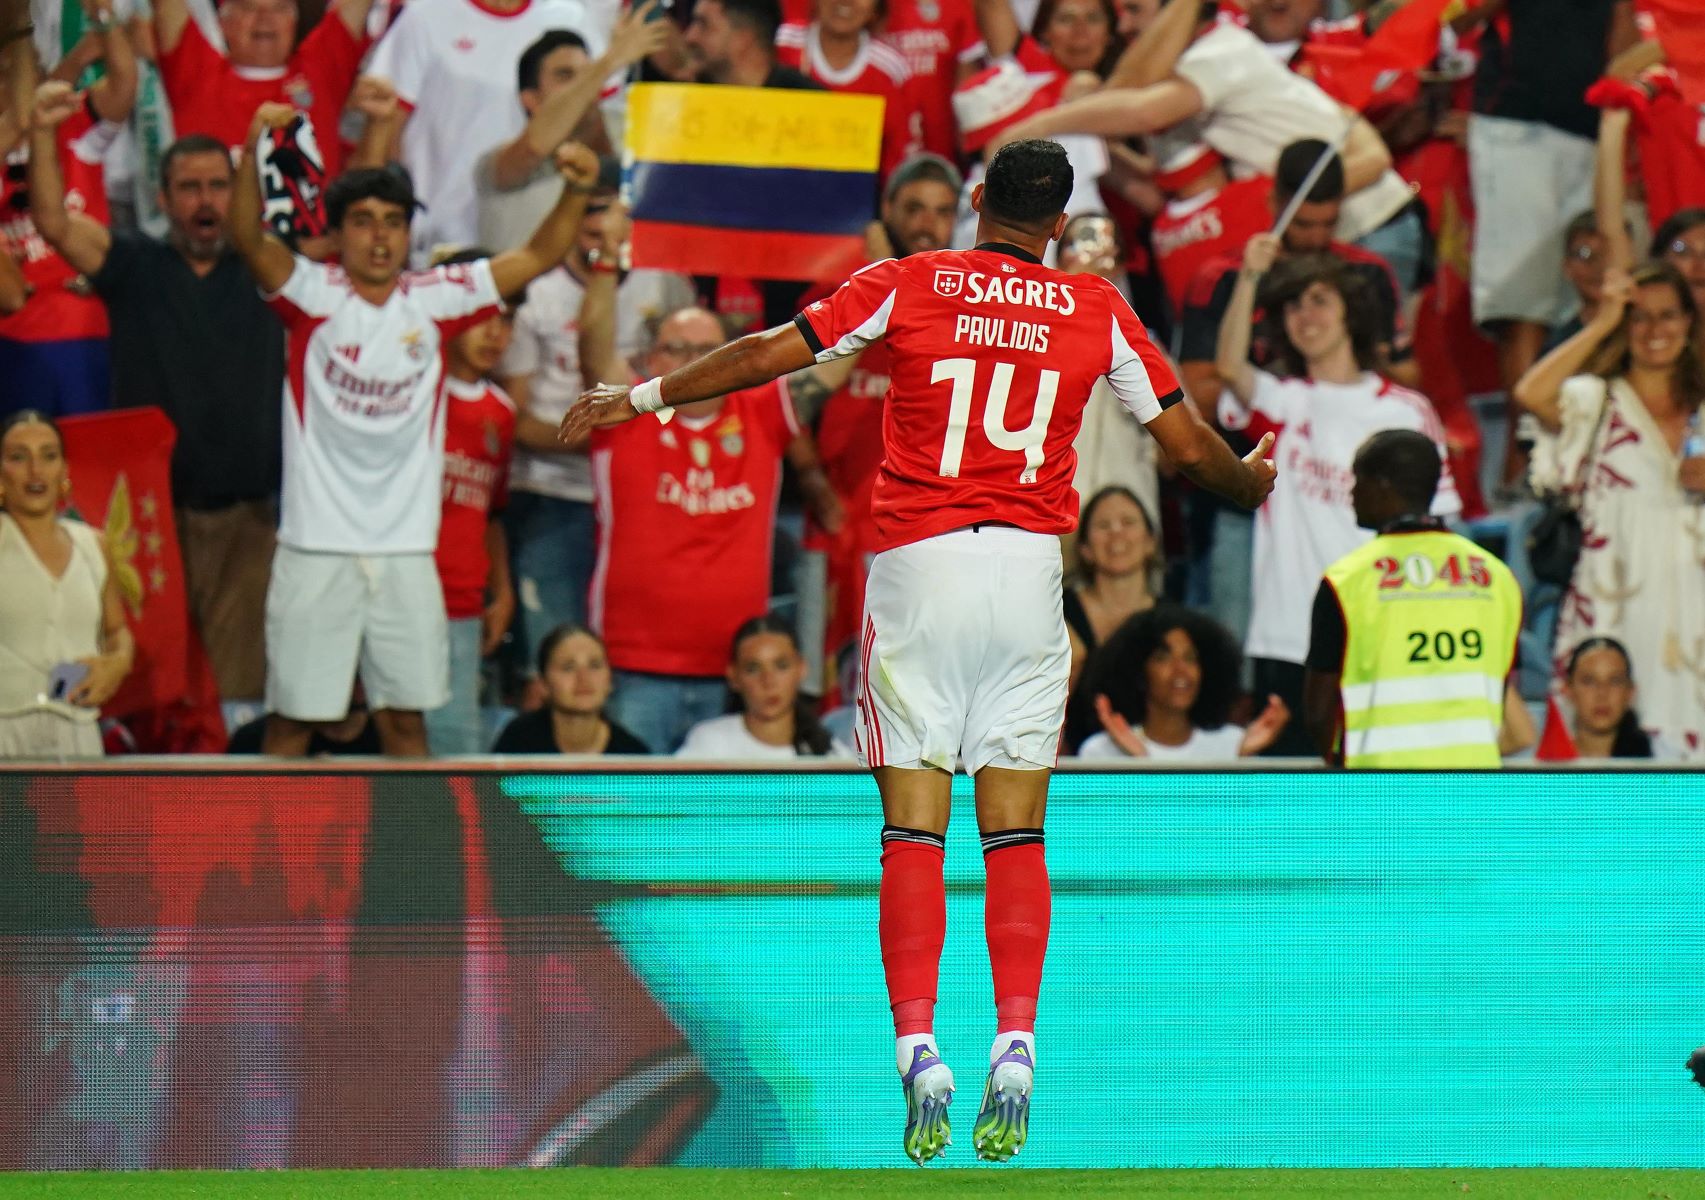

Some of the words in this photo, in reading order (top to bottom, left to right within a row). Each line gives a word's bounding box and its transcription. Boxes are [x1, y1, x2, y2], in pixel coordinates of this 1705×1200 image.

[964, 272, 1076, 316] SAGRES
[954, 314, 1051, 354] PAVLIDIS
[323, 358, 425, 398] Emir
[930, 357, 1061, 485] 14
[1373, 553, 1492, 590] 2045
[1408, 629, 1483, 662] 209
